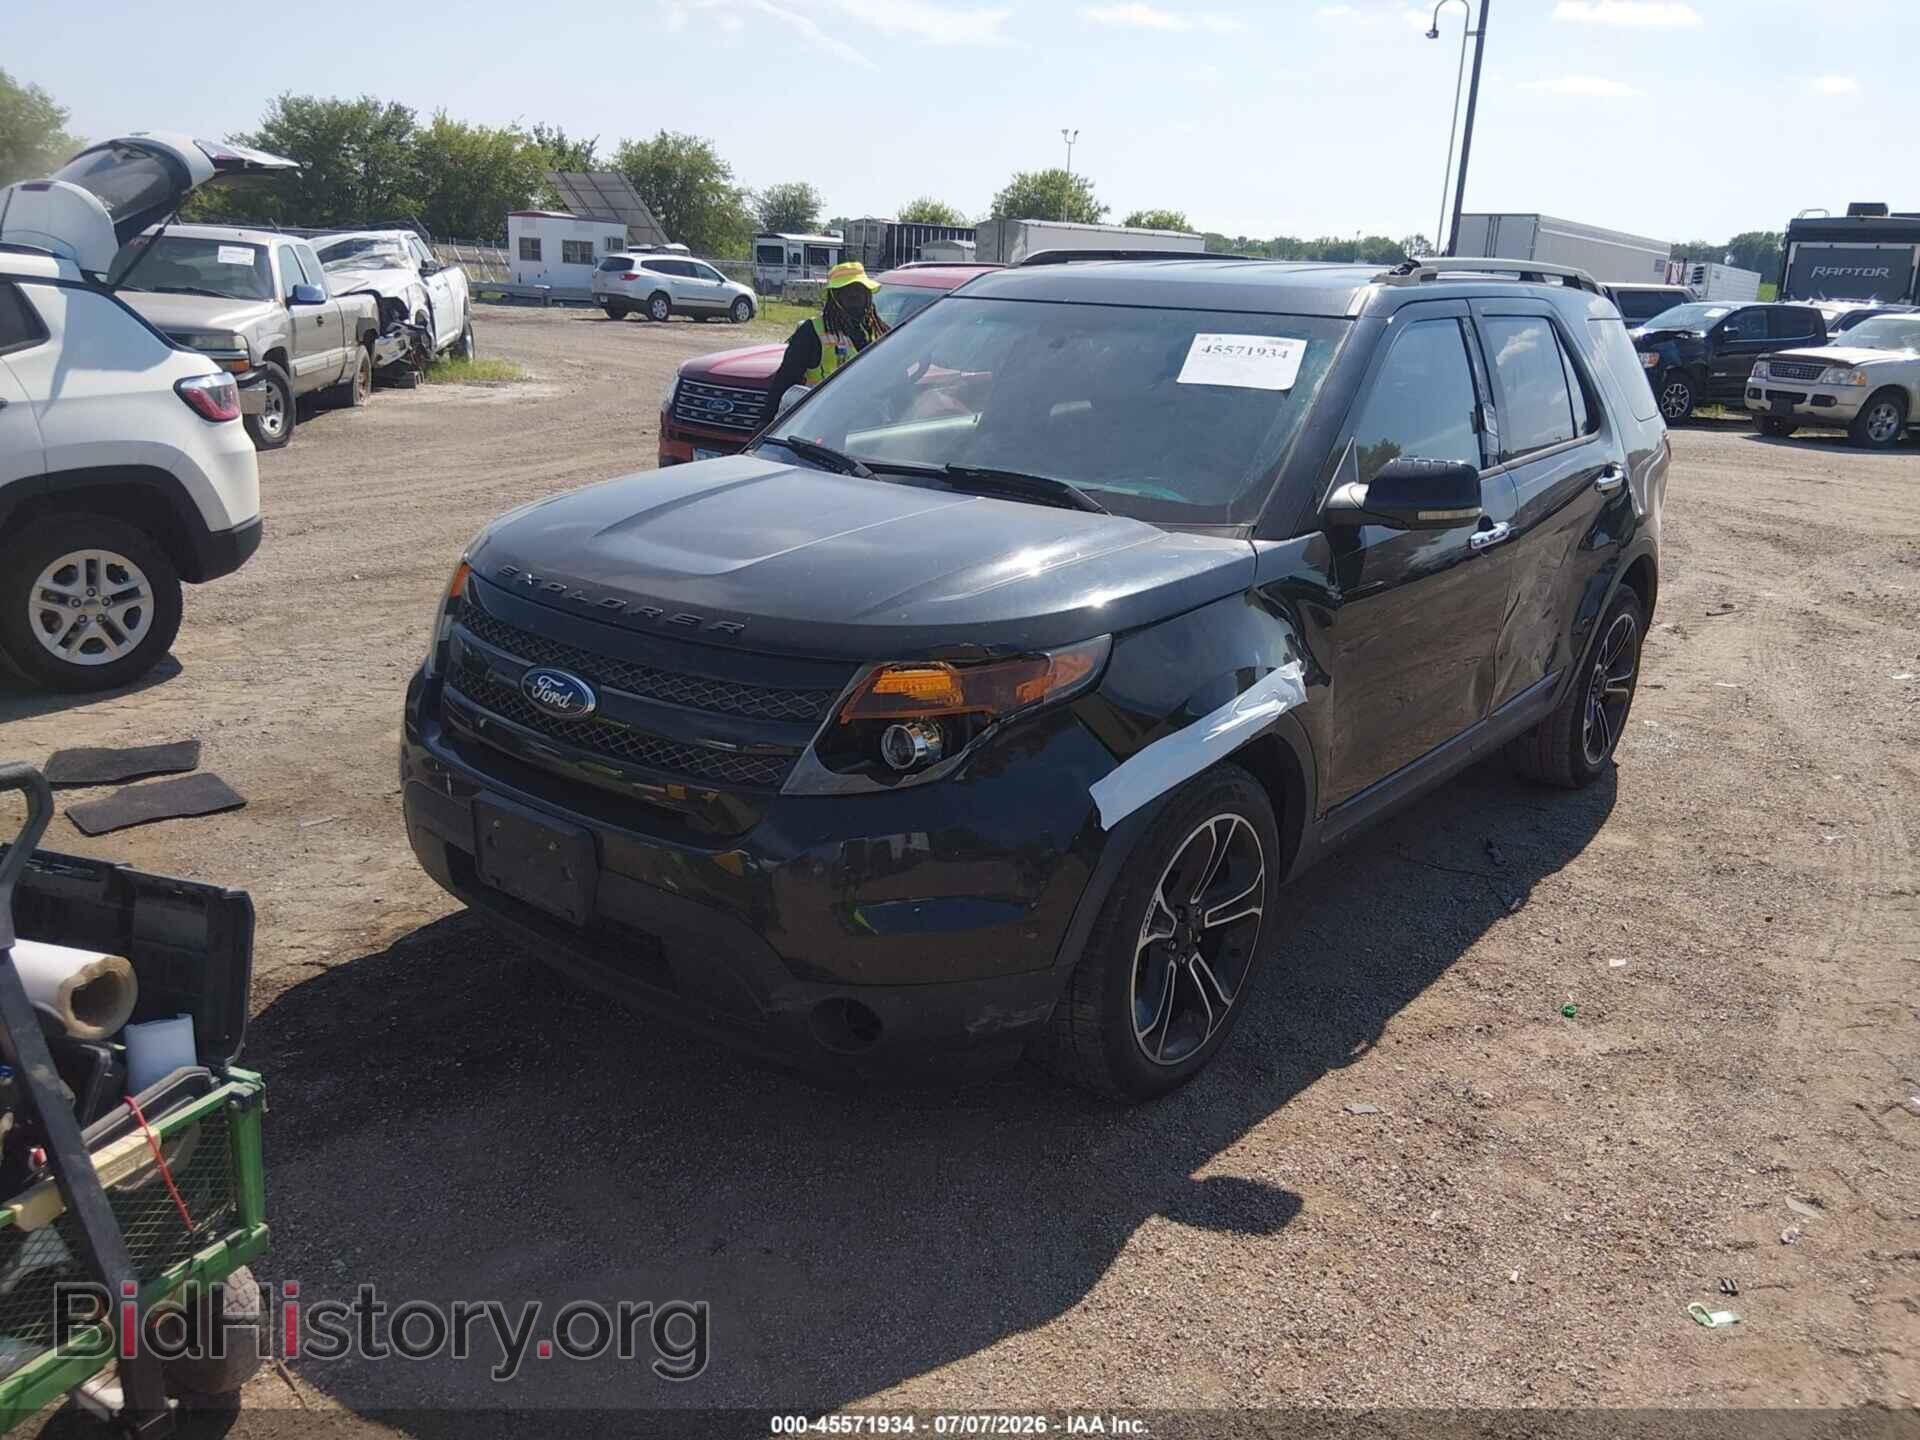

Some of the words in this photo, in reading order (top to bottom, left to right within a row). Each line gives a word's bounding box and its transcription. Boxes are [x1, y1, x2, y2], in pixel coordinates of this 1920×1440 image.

[1810, 265, 1890, 279] RAPTOR
[1200, 343, 1289, 360] 45571934
[499, 564, 746, 635] EXPLORER
[531, 674, 574, 710] Ford
